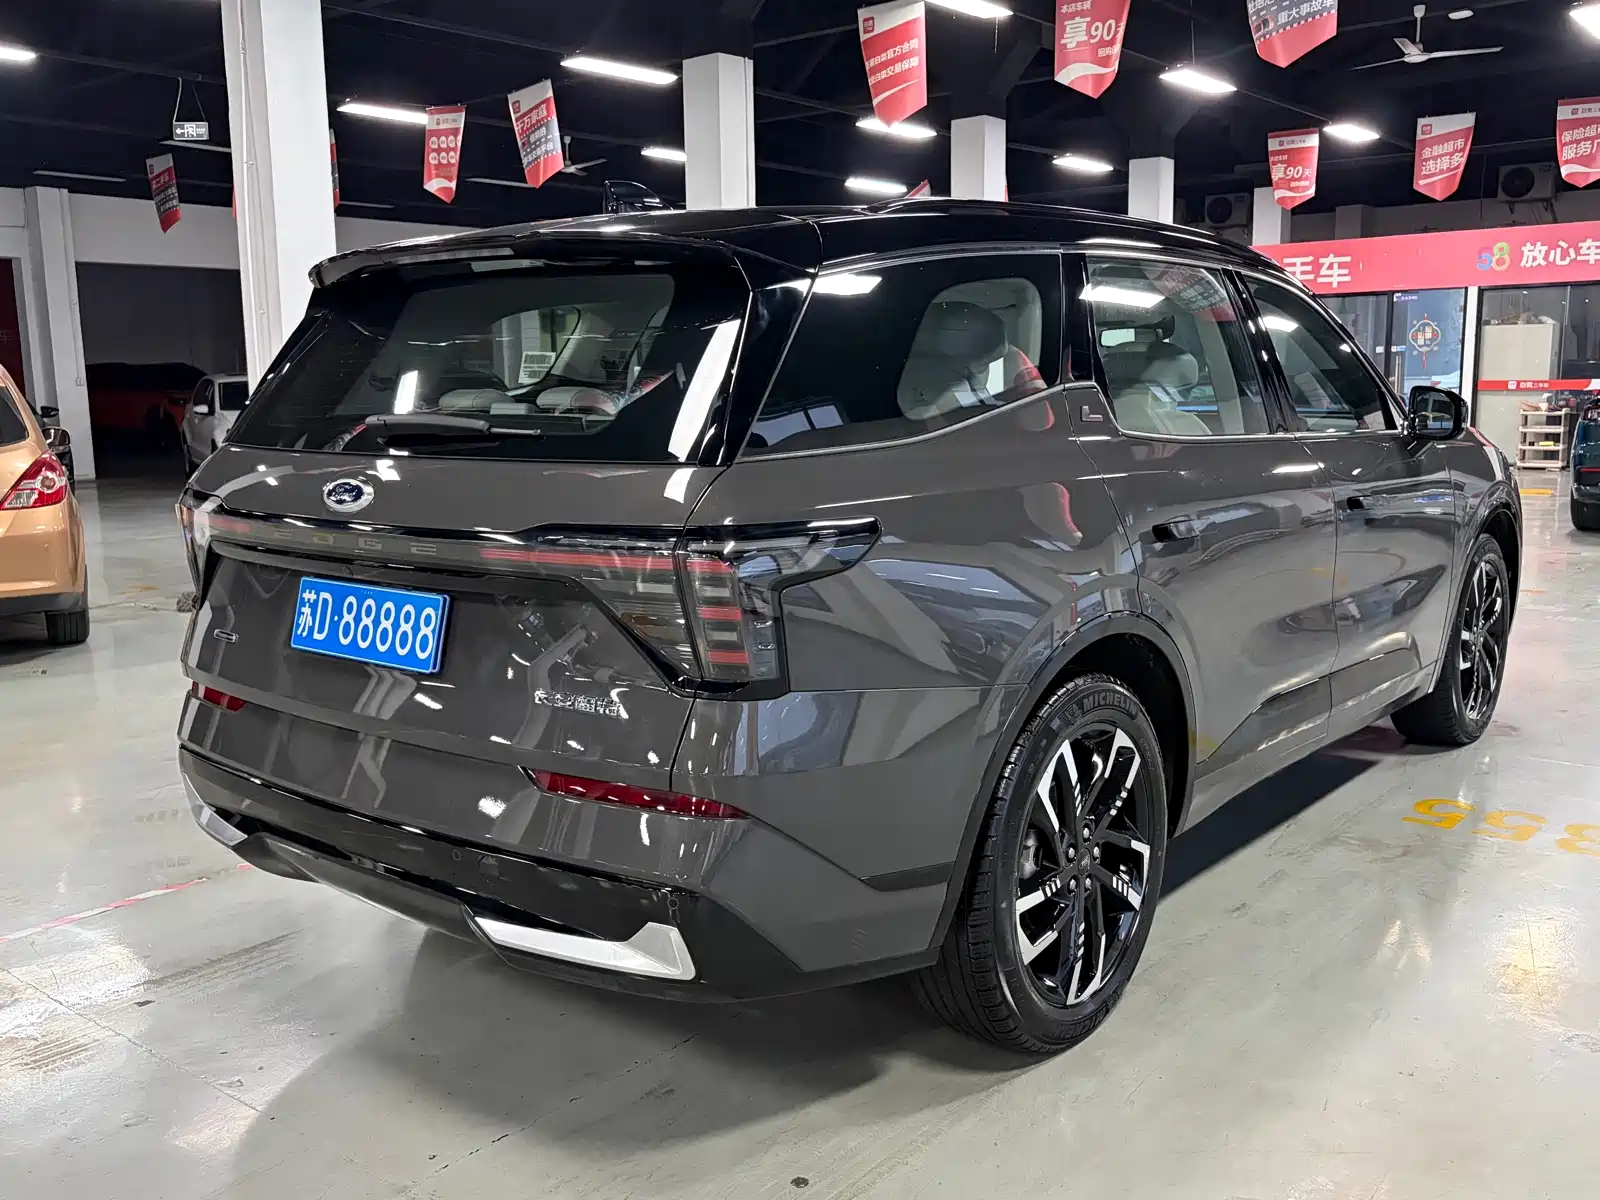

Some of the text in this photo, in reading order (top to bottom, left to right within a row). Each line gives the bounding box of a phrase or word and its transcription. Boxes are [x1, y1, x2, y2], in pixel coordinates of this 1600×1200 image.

[1561, 123, 1600, 144] 保险超
[1421, 138, 1465, 159] 金融超市
[1420, 152, 1464, 175] 选择多
[1477, 238, 1600, 271] 58 放心车
[1083, 691, 1138, 716] MICHELIN
